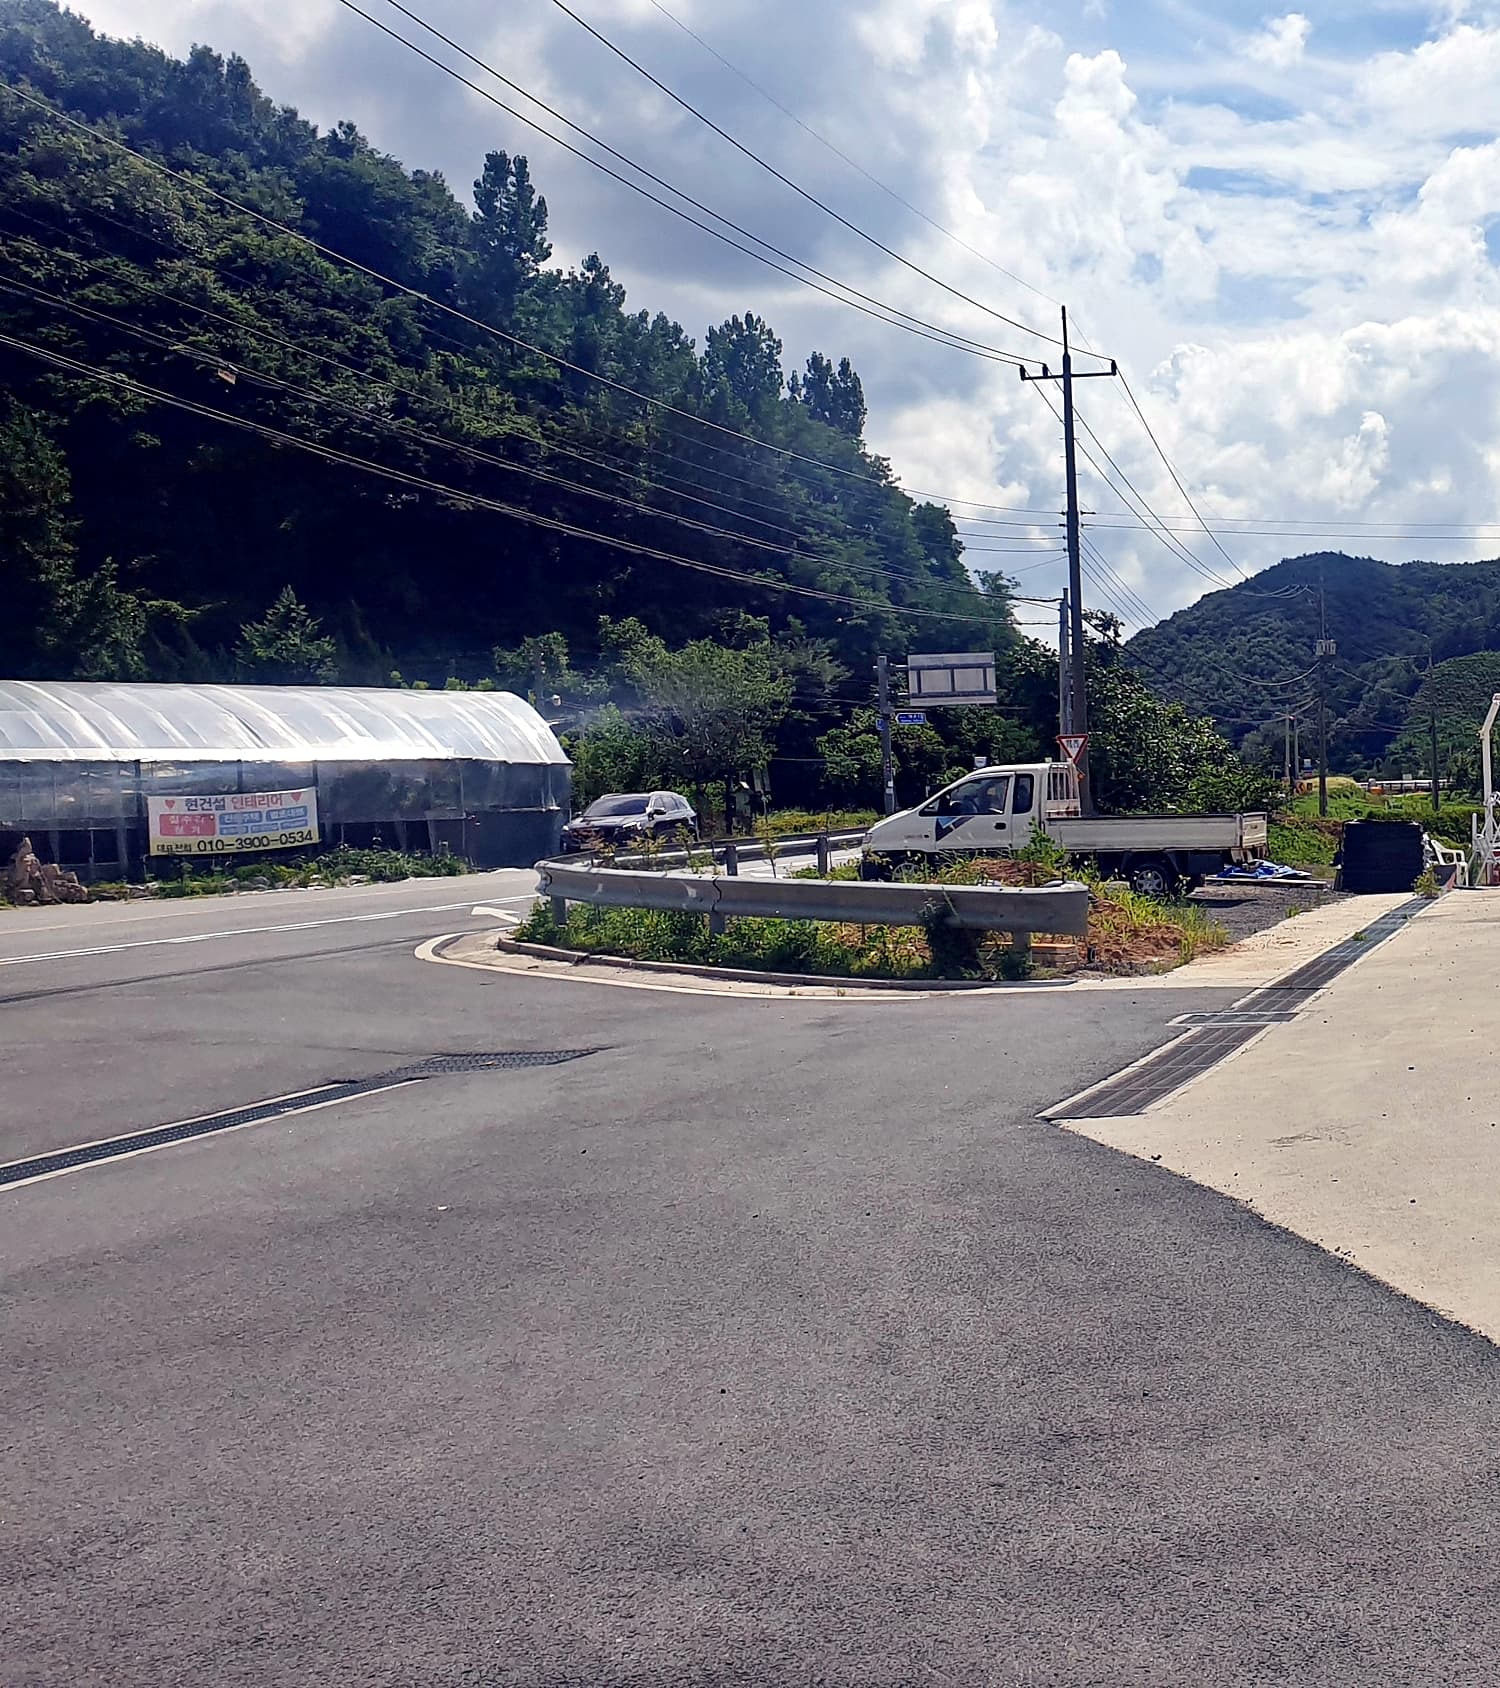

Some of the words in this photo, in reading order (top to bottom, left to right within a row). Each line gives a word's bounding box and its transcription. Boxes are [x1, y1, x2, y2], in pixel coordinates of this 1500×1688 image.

[184, 797, 226, 812] 현건설
[231, 793, 283, 811] 인테리어
[197, 830, 313, 852] 010-3900-0534
